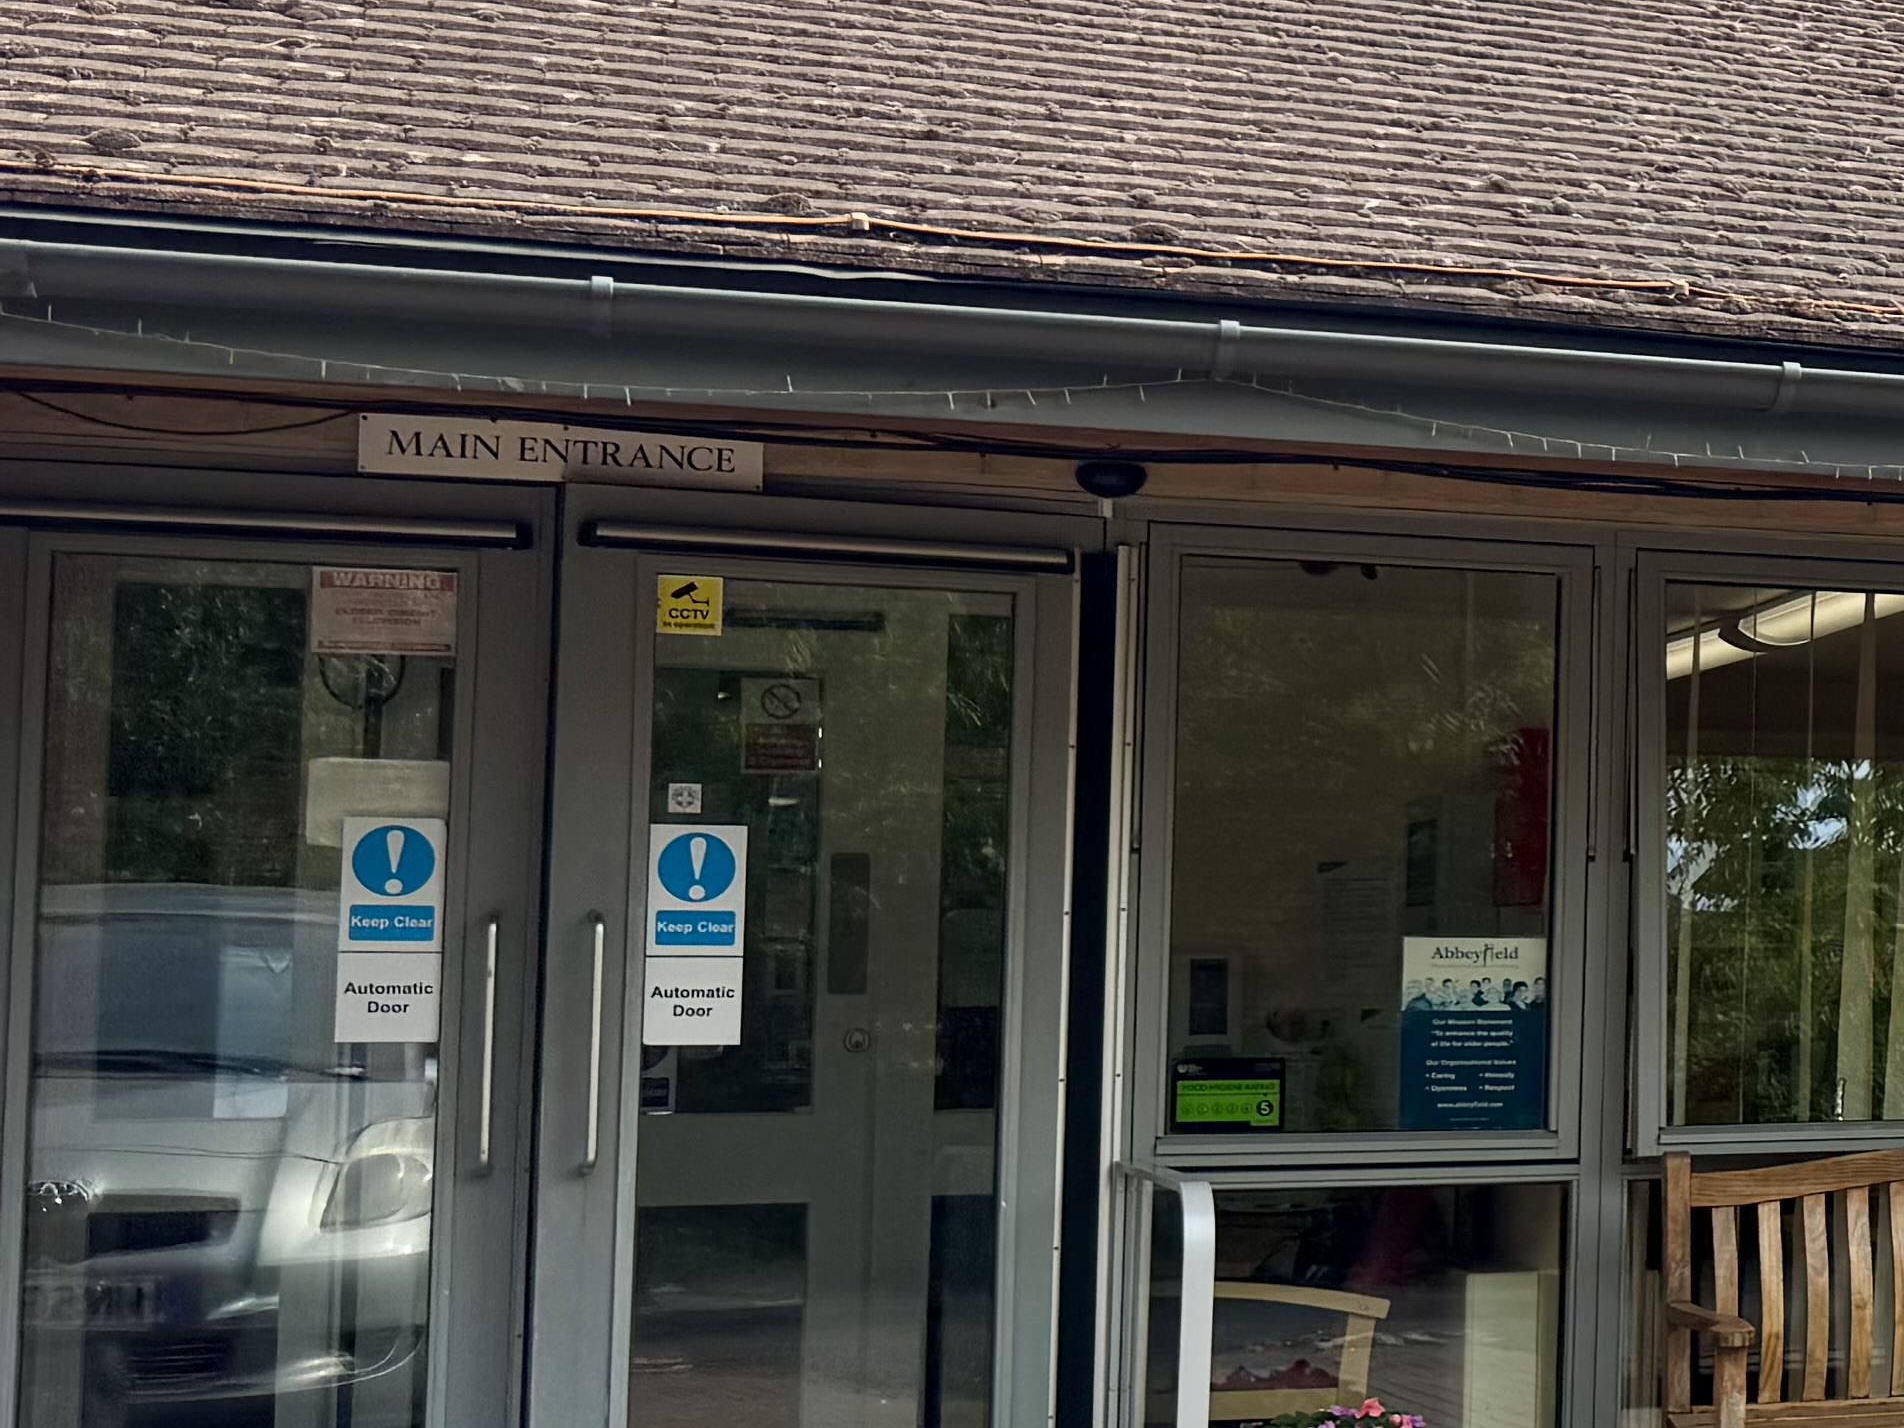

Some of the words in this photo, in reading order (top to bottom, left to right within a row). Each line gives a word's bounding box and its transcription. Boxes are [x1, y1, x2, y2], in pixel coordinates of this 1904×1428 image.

[386, 430, 502, 460] MAIN
[519, 436, 735, 473] ENTRANCE
[333, 572, 441, 589] WARNING
[668, 608, 710, 620] CCTV
[351, 915, 389, 929] Keep
[394, 916, 434, 928] Clear
[657, 920, 693, 934] Keep
[697, 921, 735, 933] Clear
[1431, 943, 1520, 967] Abbeyfield
[344, 982, 434, 995] Automatic
[651, 986, 736, 999] Automatic
[367, 1001, 411, 1014] Door
[673, 1005, 713, 1017] Door
[1260, 1102, 1270, 1114] 5
